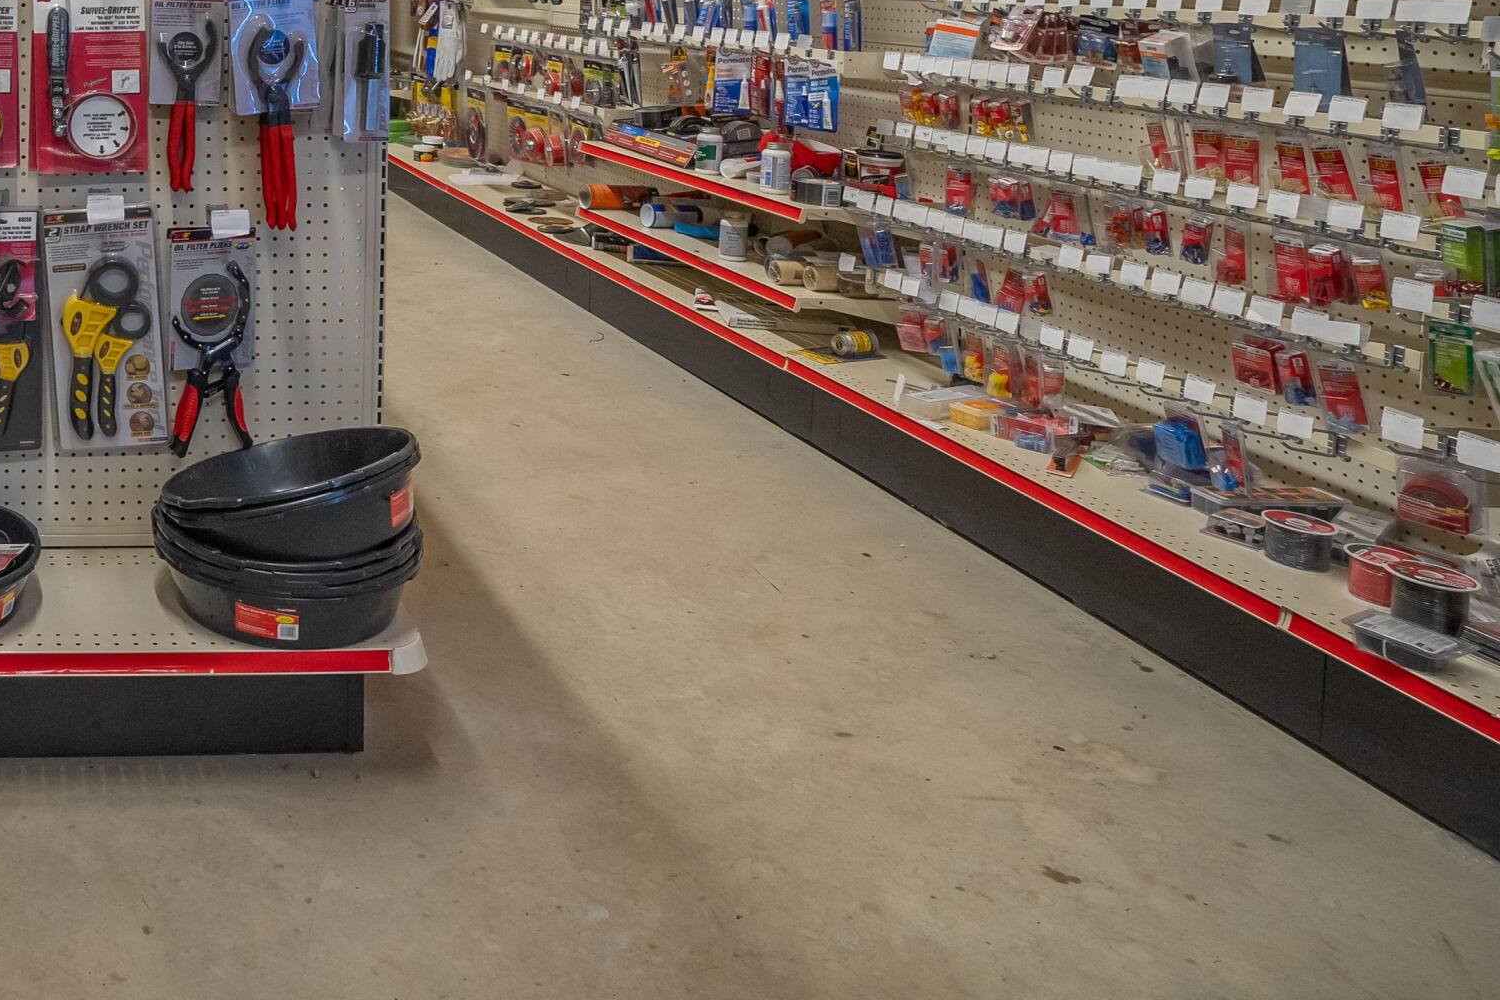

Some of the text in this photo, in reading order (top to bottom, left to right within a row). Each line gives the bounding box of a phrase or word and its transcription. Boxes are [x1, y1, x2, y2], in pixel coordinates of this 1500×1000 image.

[166, 1, 188, 9] FILTER
[188, 1, 212, 9] PLIERS
[48, 228, 58, 237] 2
[63, 220, 149, 235] STRAP WRENCH SET
[174, 241, 233, 252] OIL FILTER PLIERS
